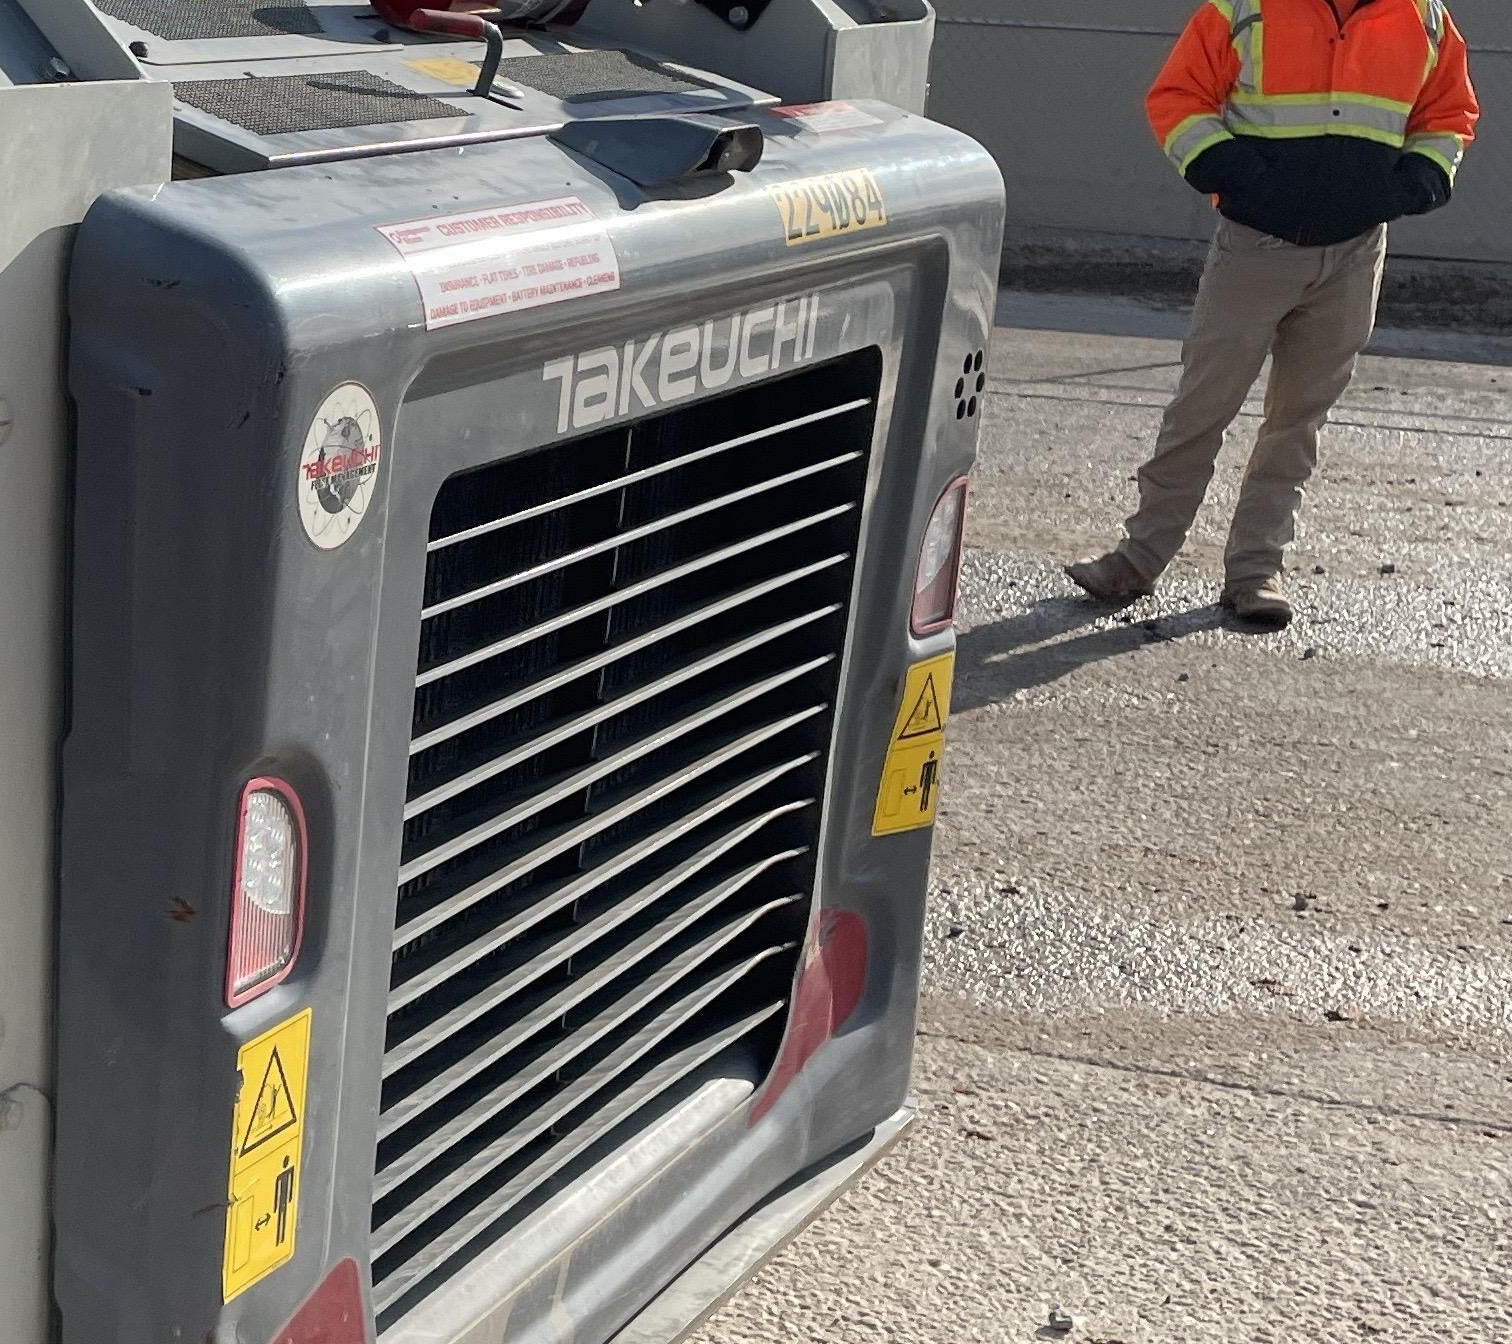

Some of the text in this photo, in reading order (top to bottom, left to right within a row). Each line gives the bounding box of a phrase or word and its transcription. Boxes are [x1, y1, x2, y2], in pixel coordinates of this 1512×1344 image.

[436, 215, 504, 237] CUSTOMER
[501, 202, 588, 225] RESPONSIBILITY
[774, 173, 884, 241] 229084
